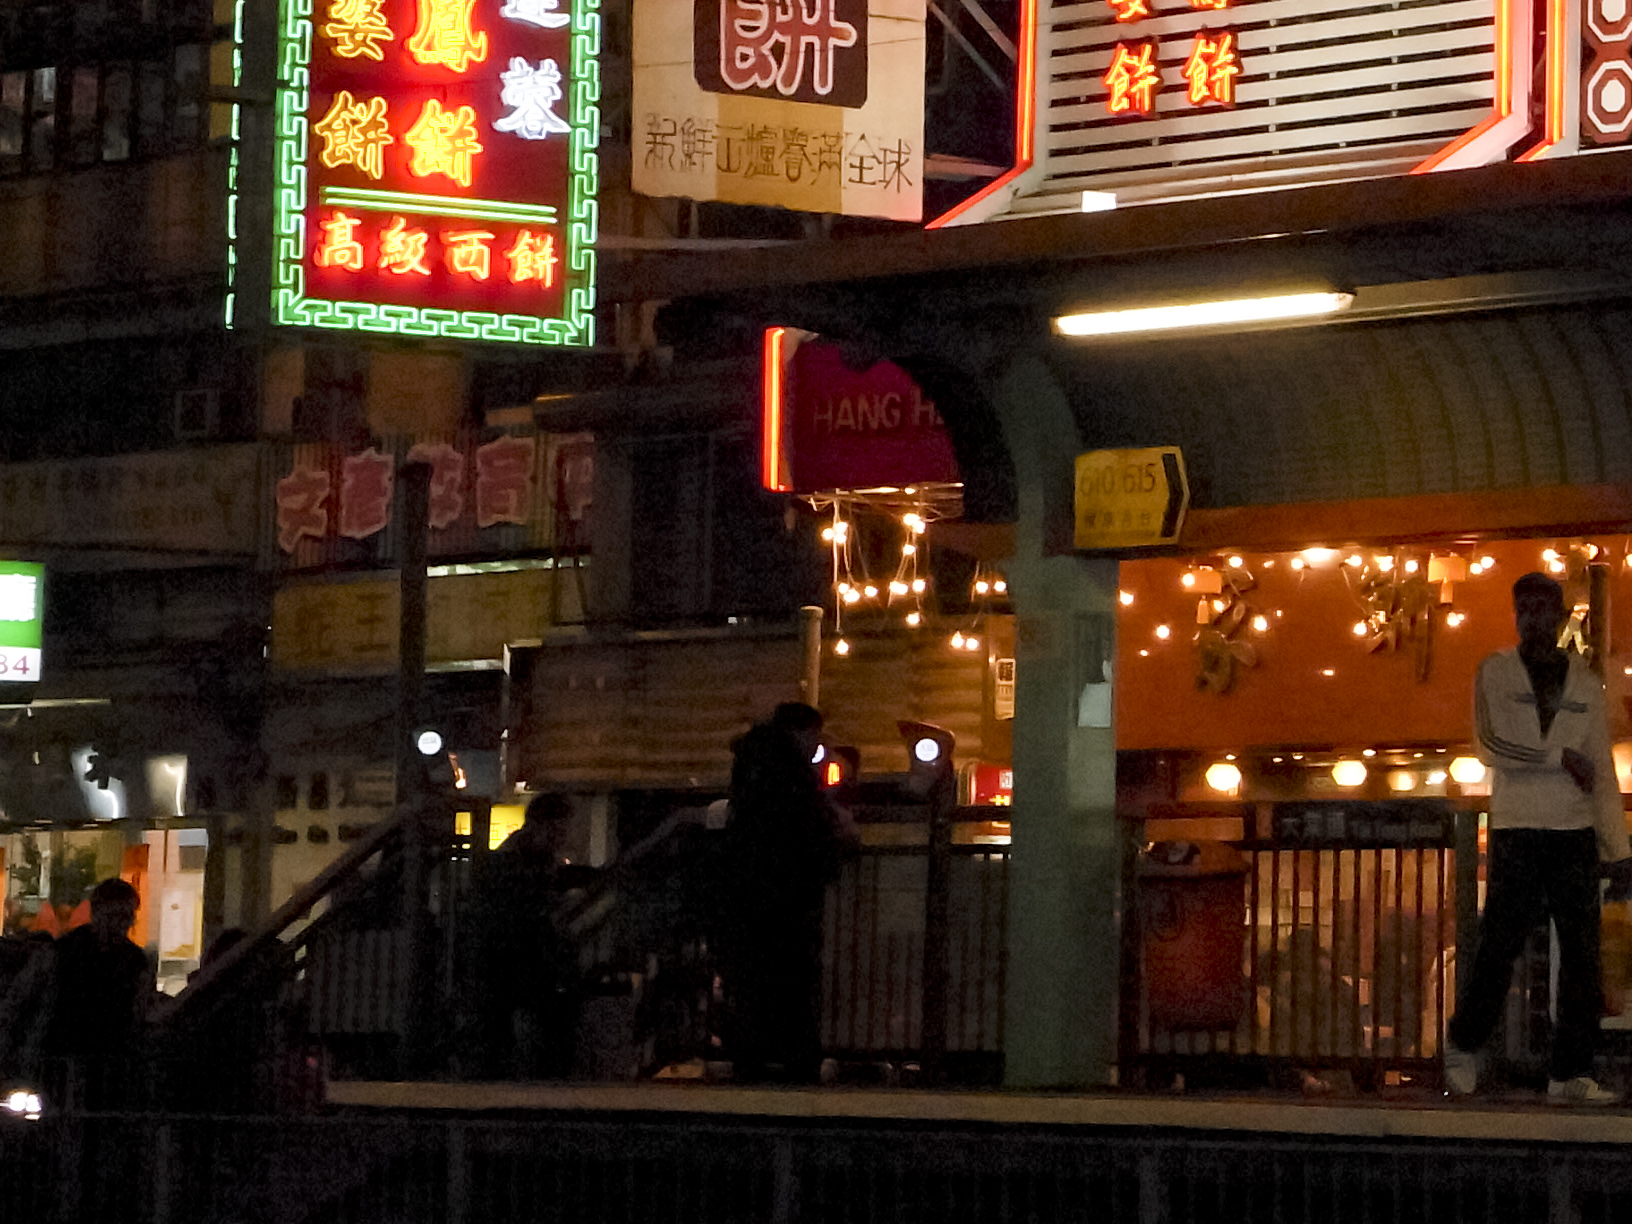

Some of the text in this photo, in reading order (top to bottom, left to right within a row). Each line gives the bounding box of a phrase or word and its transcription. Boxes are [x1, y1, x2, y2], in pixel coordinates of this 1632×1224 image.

[314, 210, 560, 288] 高級西餅
[812, 390, 902, 435] HANG
